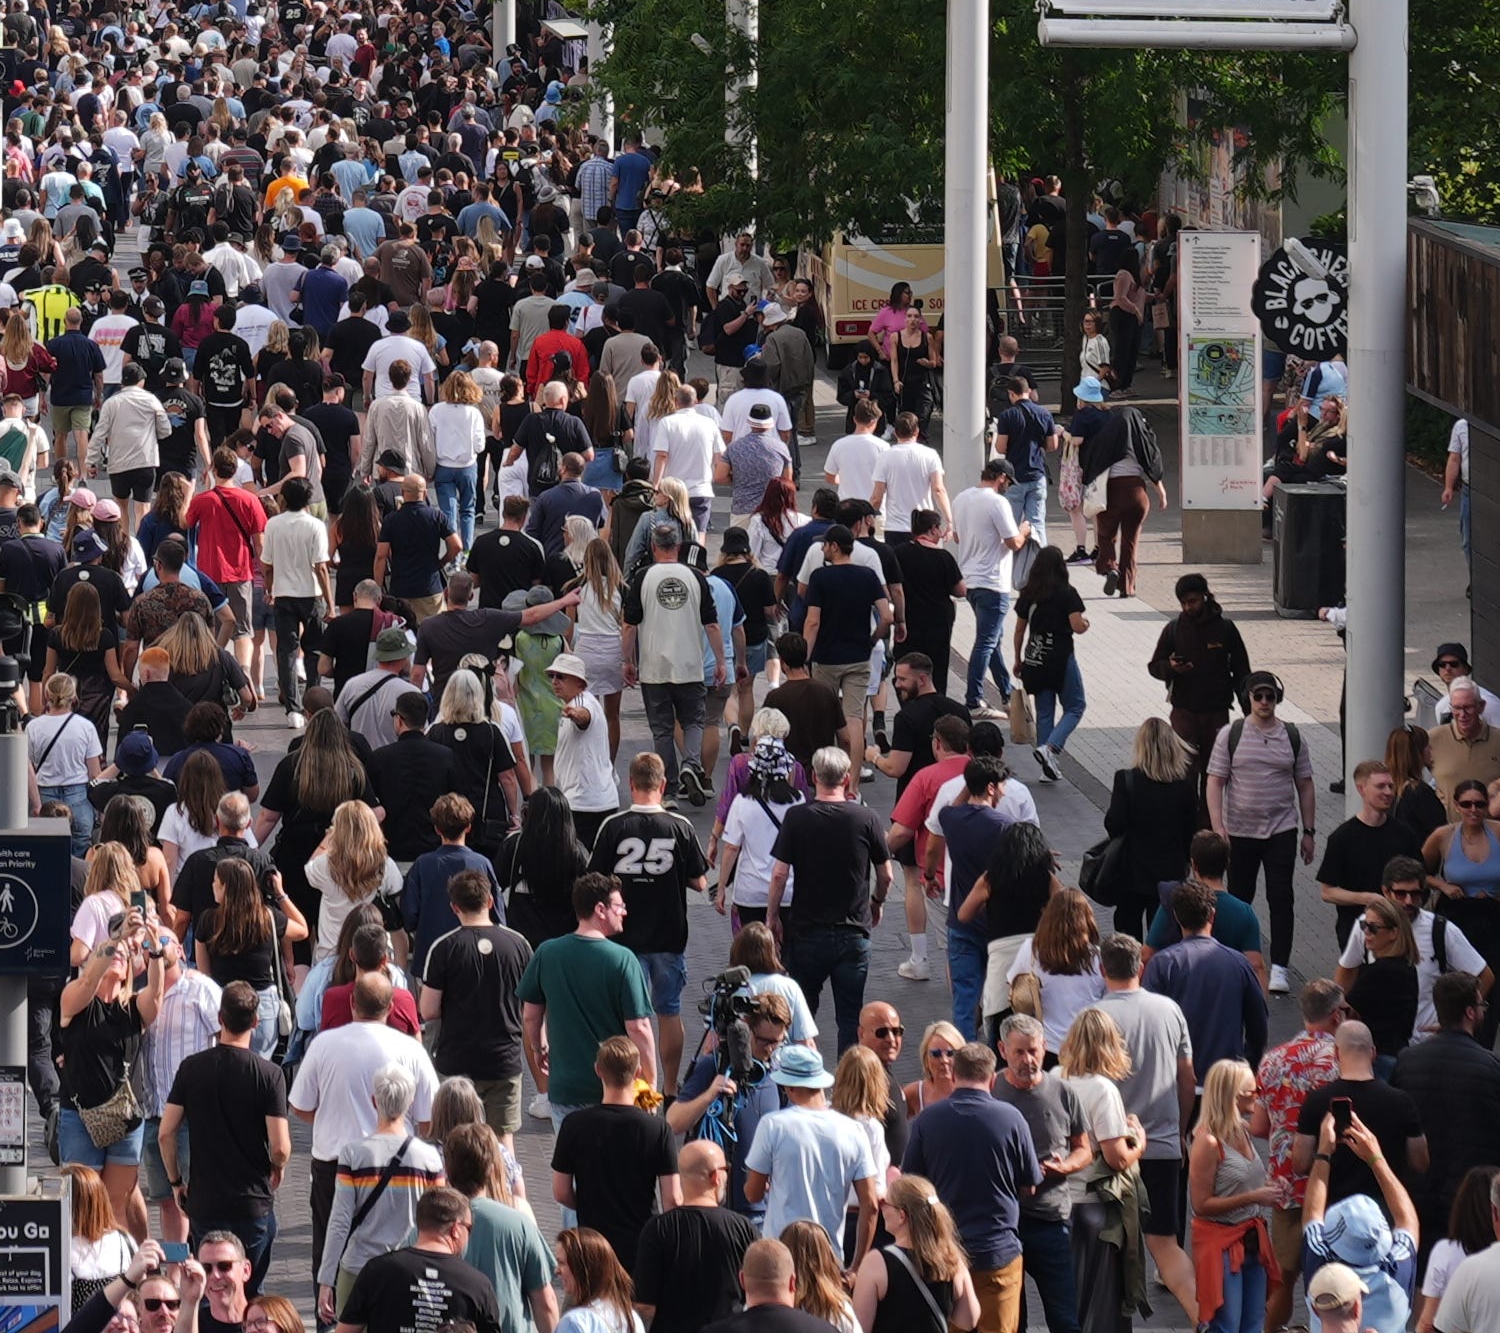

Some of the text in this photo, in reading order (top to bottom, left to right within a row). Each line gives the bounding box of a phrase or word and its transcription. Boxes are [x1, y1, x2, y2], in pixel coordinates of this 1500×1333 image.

[286, 8, 301, 20] 25
[852, 299, 866, 310] ICE
[613, 837, 676, 874] 25
[8, 859, 36, 869] Priority
[24, 1221, 50, 1239] Go
